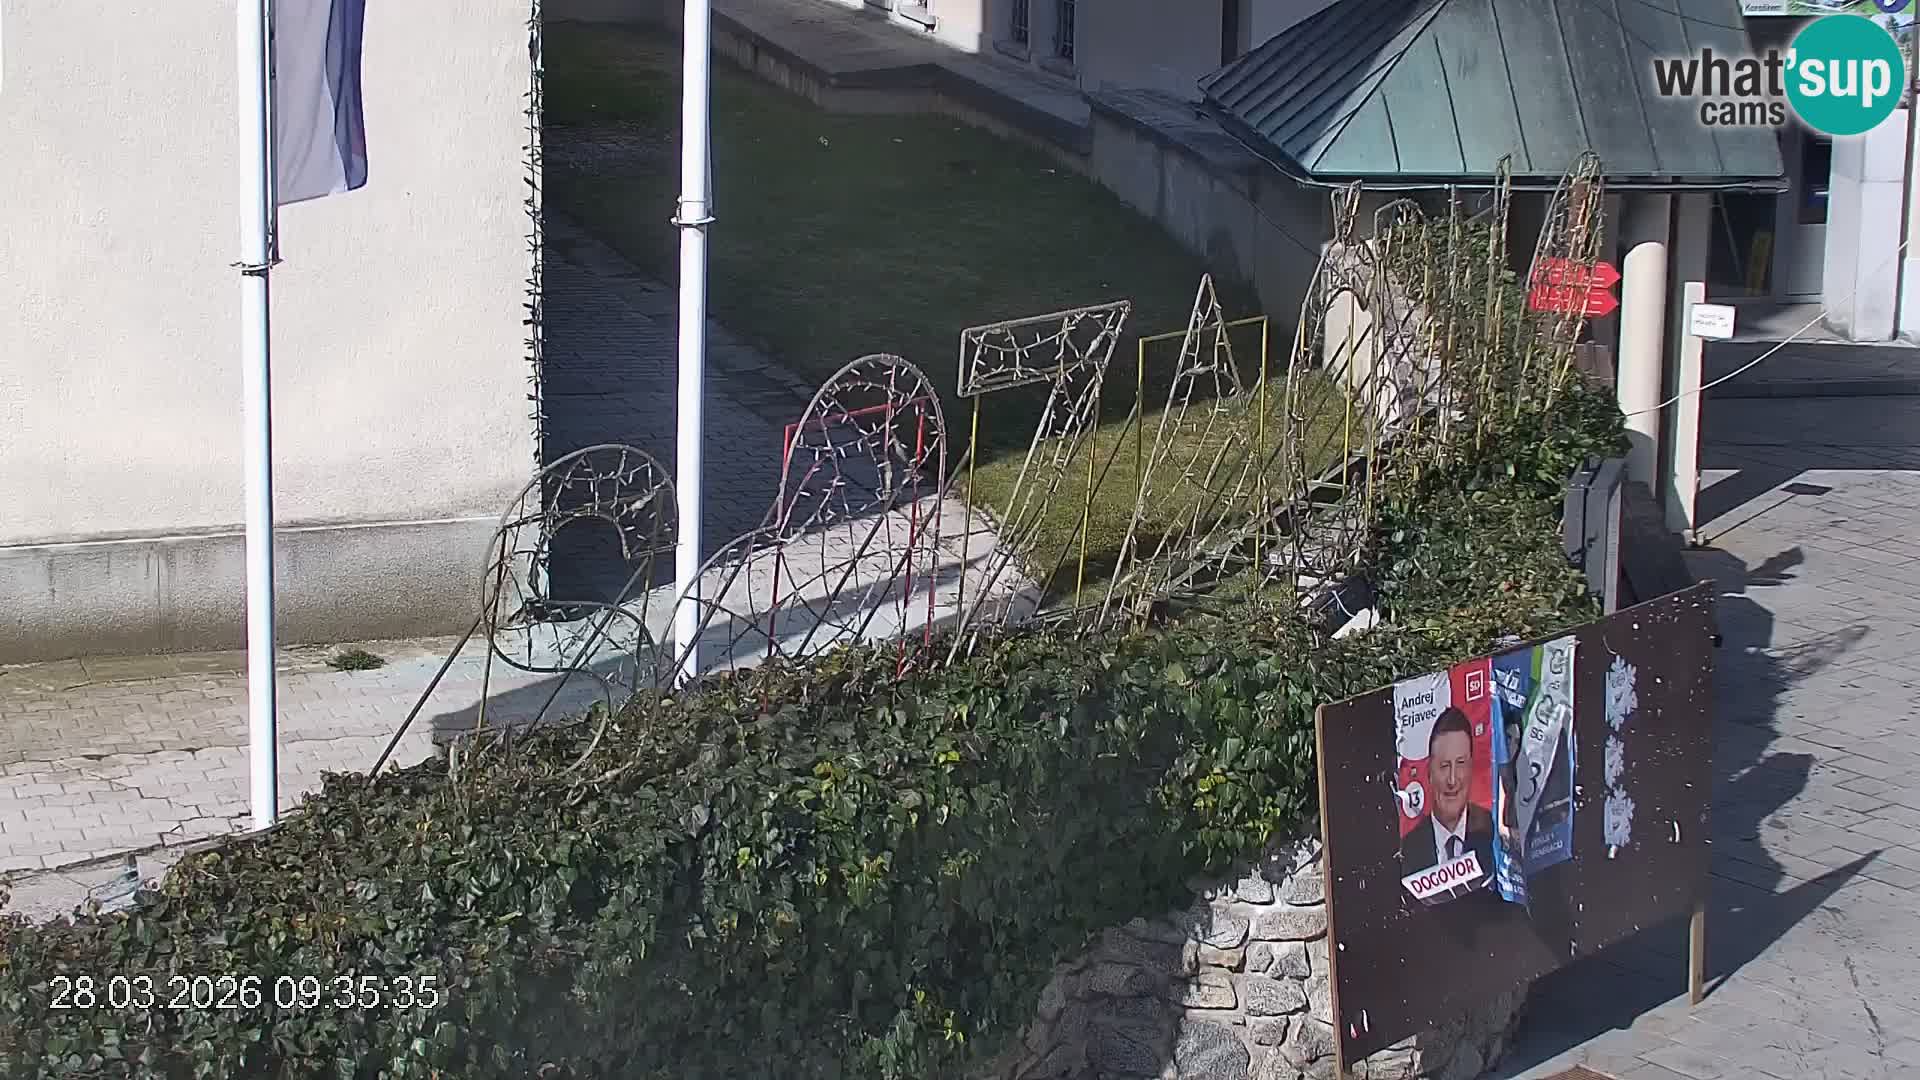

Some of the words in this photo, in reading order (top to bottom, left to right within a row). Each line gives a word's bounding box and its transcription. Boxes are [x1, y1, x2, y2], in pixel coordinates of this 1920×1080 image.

[1469, 679, 1481, 692] SD
[1401, 689, 1434, 710] Andrej
[1402, 708, 1437, 728] Erjavec
[1408, 790, 1420, 808] 13
[1411, 857, 1475, 894] DOGOVOR
